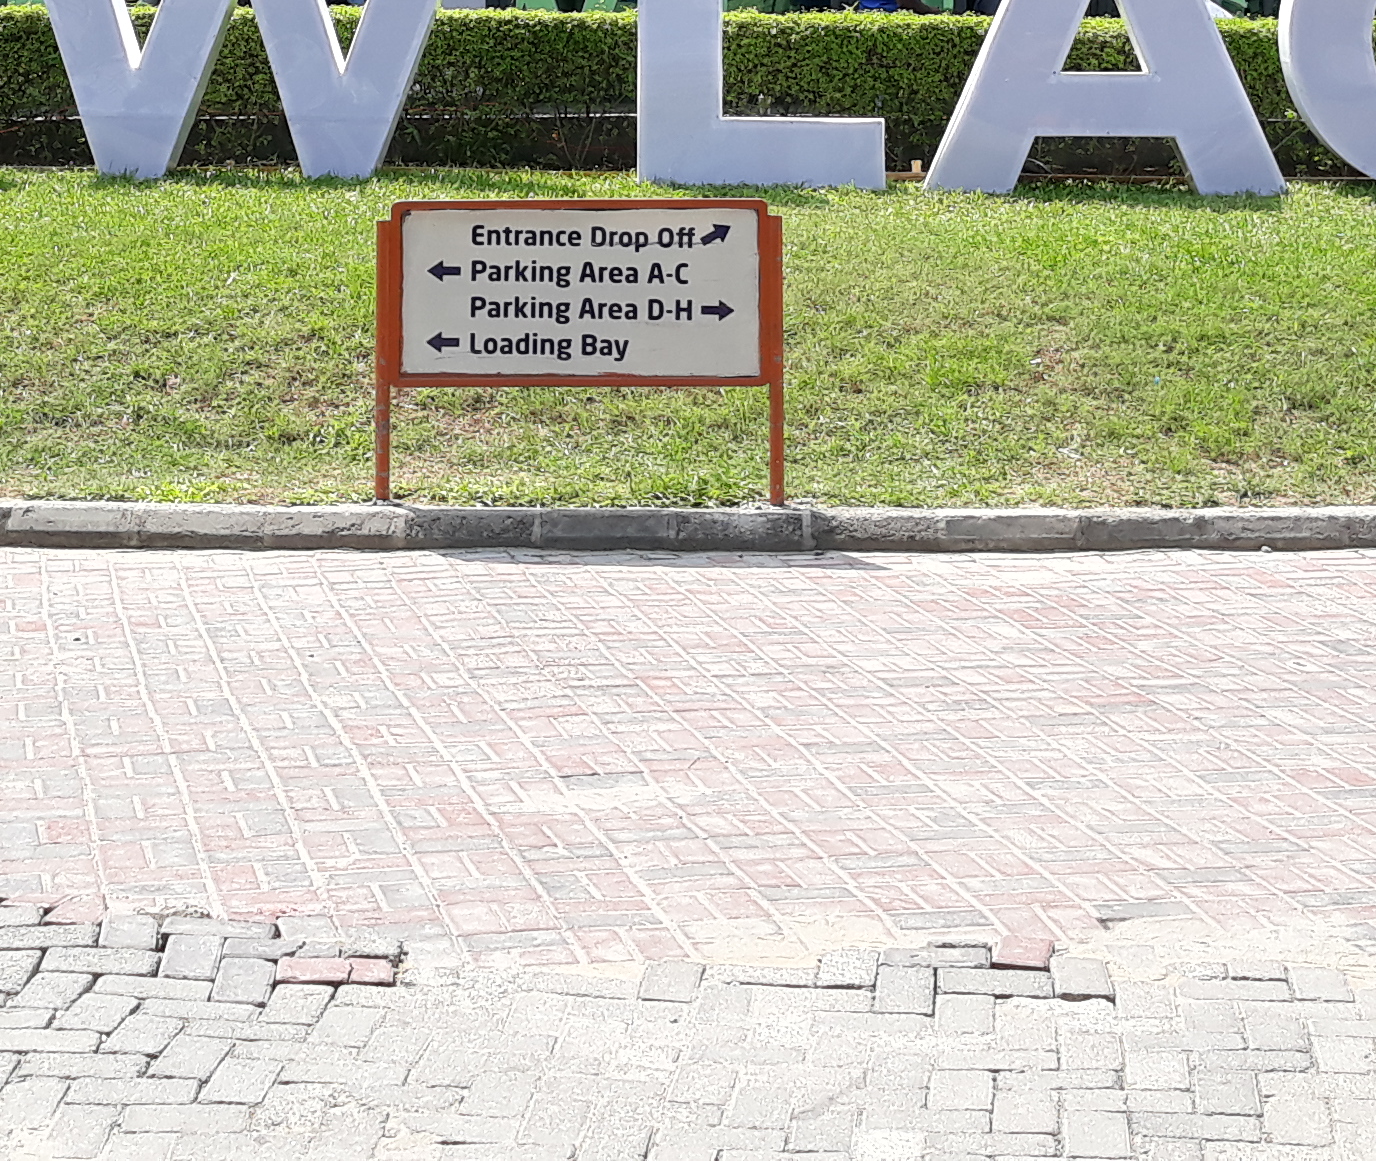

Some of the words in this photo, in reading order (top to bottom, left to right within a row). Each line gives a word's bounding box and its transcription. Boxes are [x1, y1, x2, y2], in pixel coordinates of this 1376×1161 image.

[471, 224, 582, 248] Entrance
[591, 226, 649, 252] Drop
[657, 227, 696, 249] Off
[470, 260, 572, 288] Parking
[579, 261, 639, 284] Area
[647, 263, 690, 285] A-C
[470, 296, 571, 324] Parking
[579, 298, 638, 321] Area
[647, 299, 693, 321] D-H
[469, 333, 572, 361] Loading
[581, 334, 629, 361] Bay
